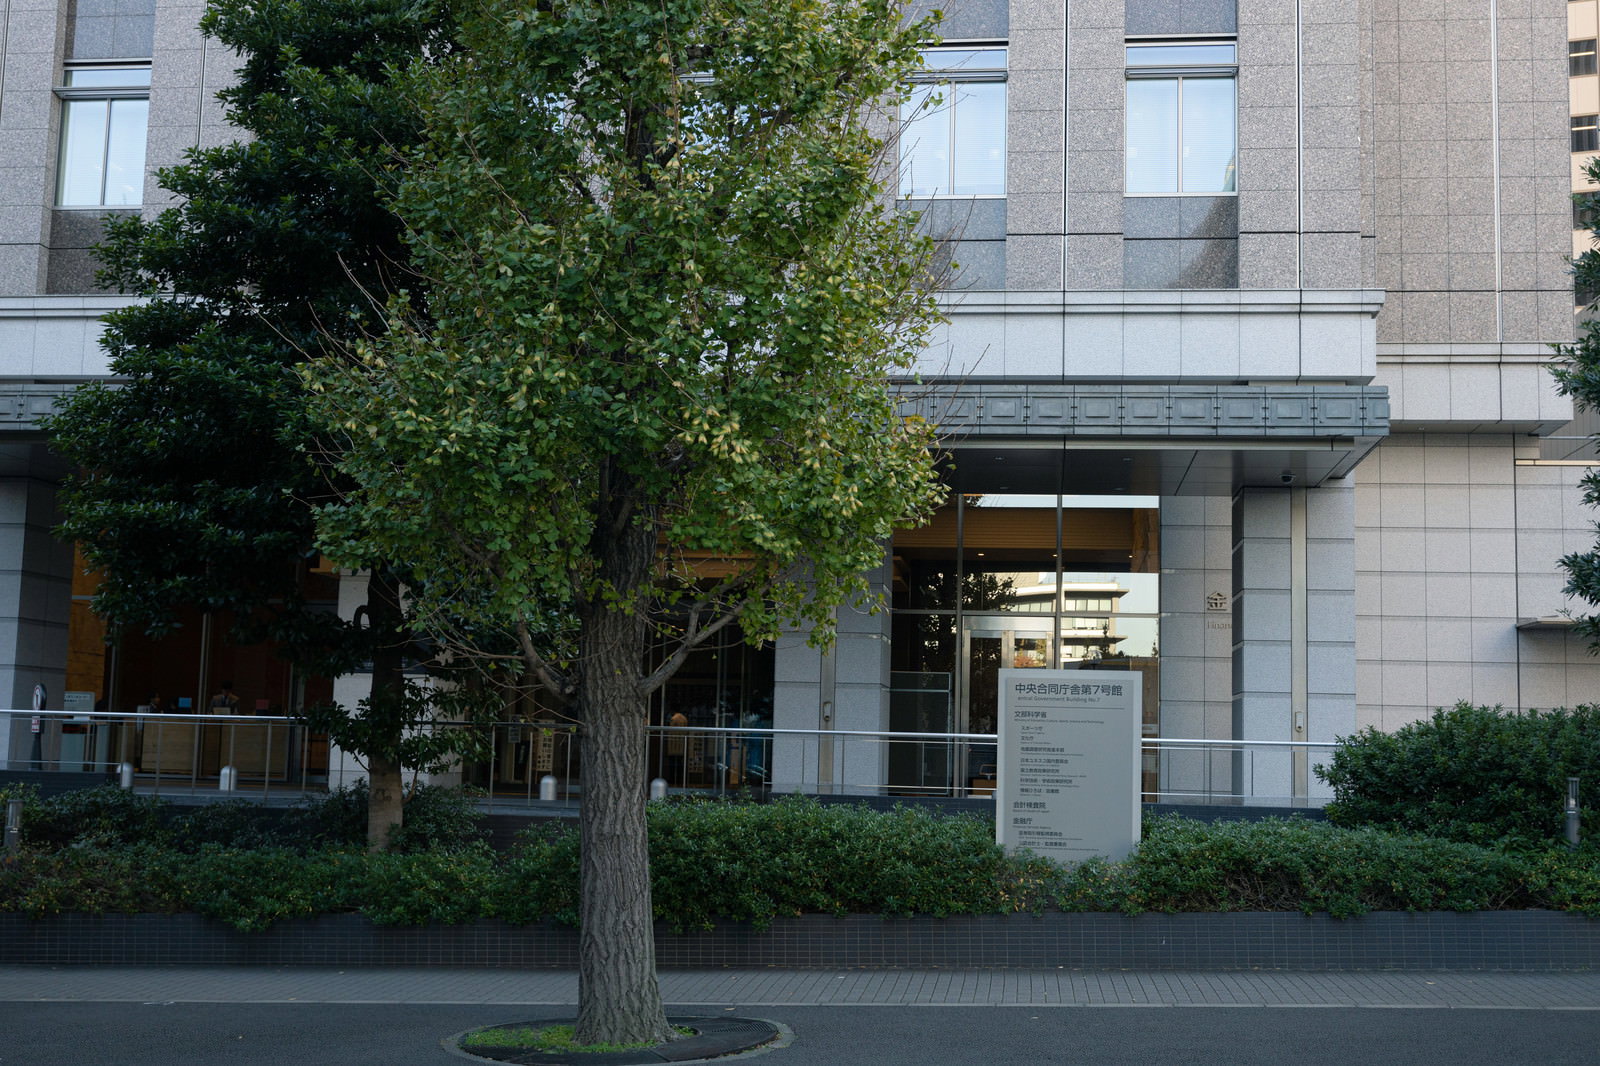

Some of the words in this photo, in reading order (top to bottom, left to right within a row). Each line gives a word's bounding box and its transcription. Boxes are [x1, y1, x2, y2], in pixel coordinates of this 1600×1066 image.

[1015, 683, 1123, 697] 中央合同庁舎第7号館
